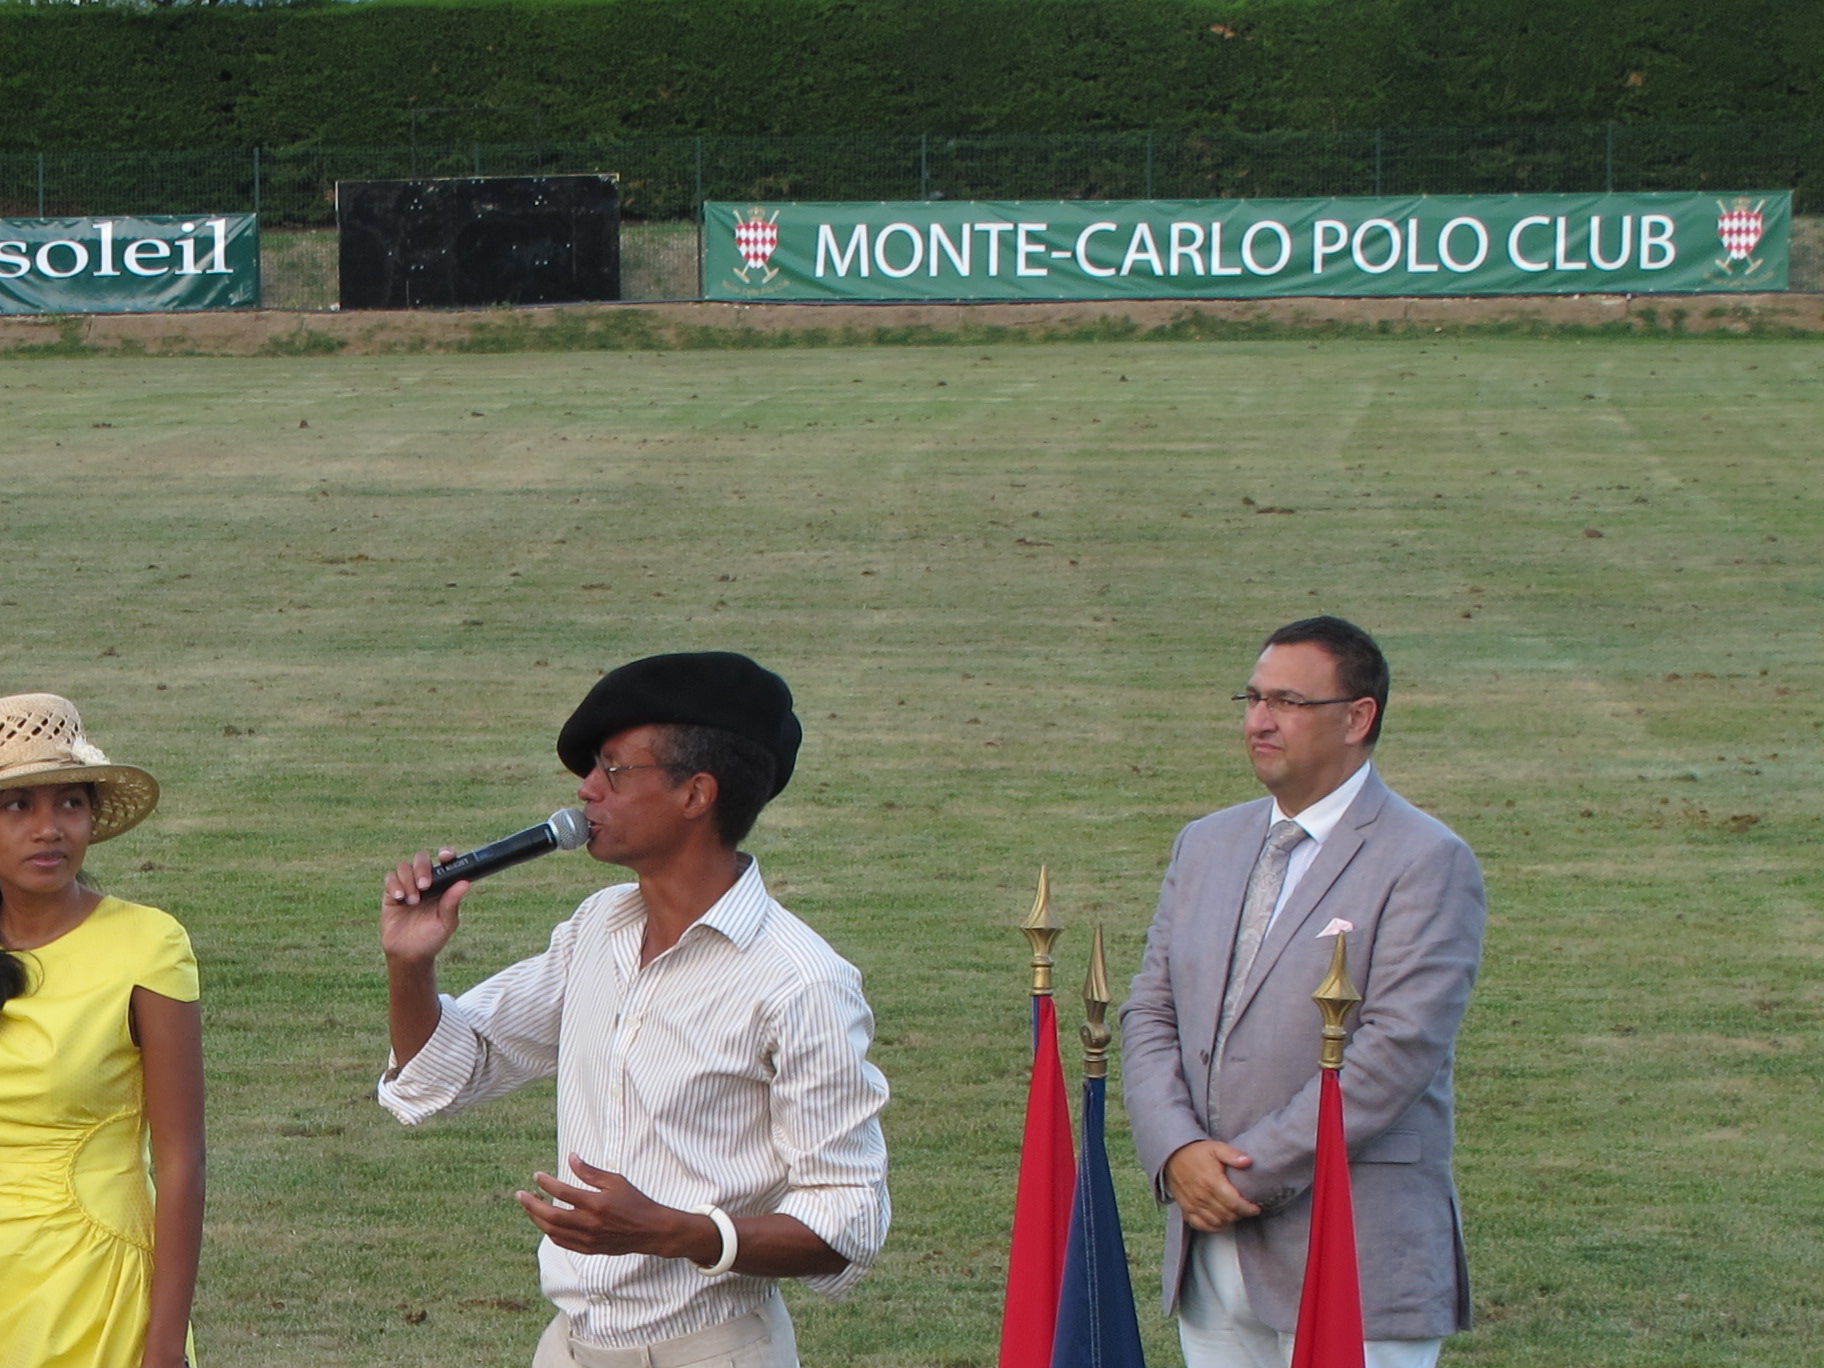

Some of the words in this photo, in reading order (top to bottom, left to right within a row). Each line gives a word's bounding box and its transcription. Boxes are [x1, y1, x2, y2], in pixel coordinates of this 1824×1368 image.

[814, 220, 1292, 278] MONTE-CARLO
[1312, 216, 1489, 274] POLO
[1507, 214, 1677, 272] CLUB
